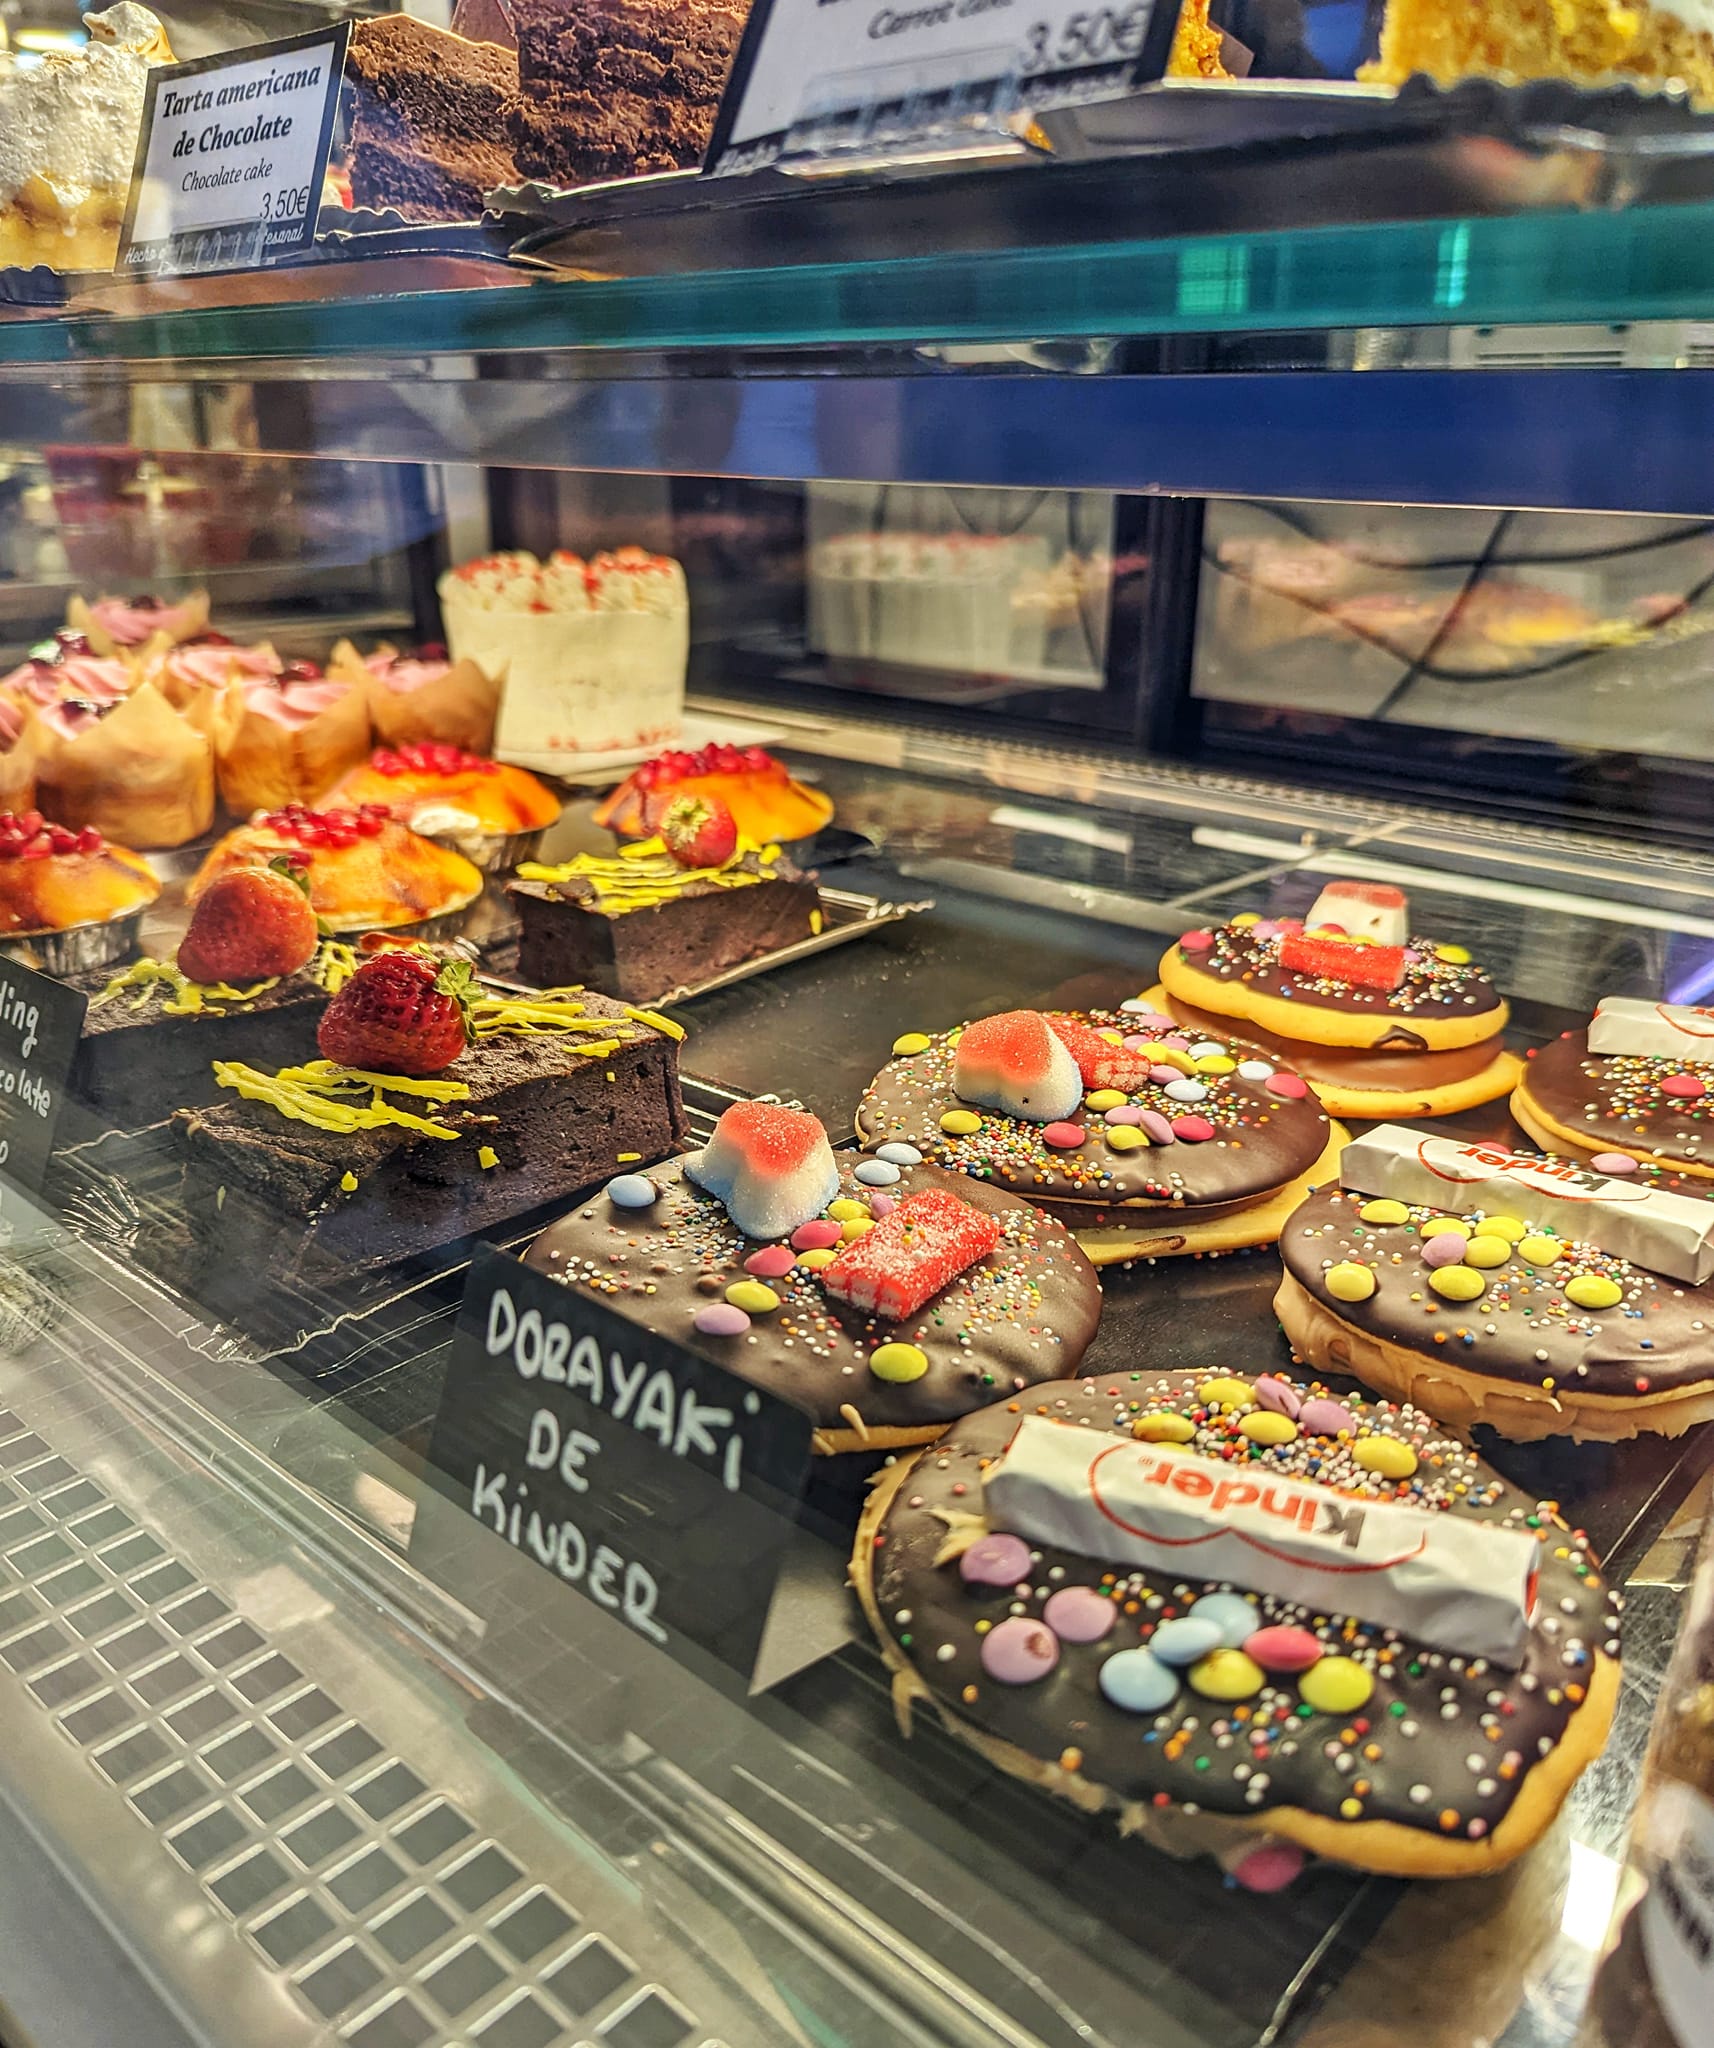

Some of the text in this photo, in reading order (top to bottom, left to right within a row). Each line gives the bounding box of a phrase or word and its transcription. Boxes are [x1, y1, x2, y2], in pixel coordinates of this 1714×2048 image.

[162, 66, 321, 118] Tarta americana
[172, 115, 293, 158] de Chocolate
[182, 158, 273, 191] Chocolate cake
[259, 186, 309, 223] 3,50€
[525, 1408, 601, 1493] DE
